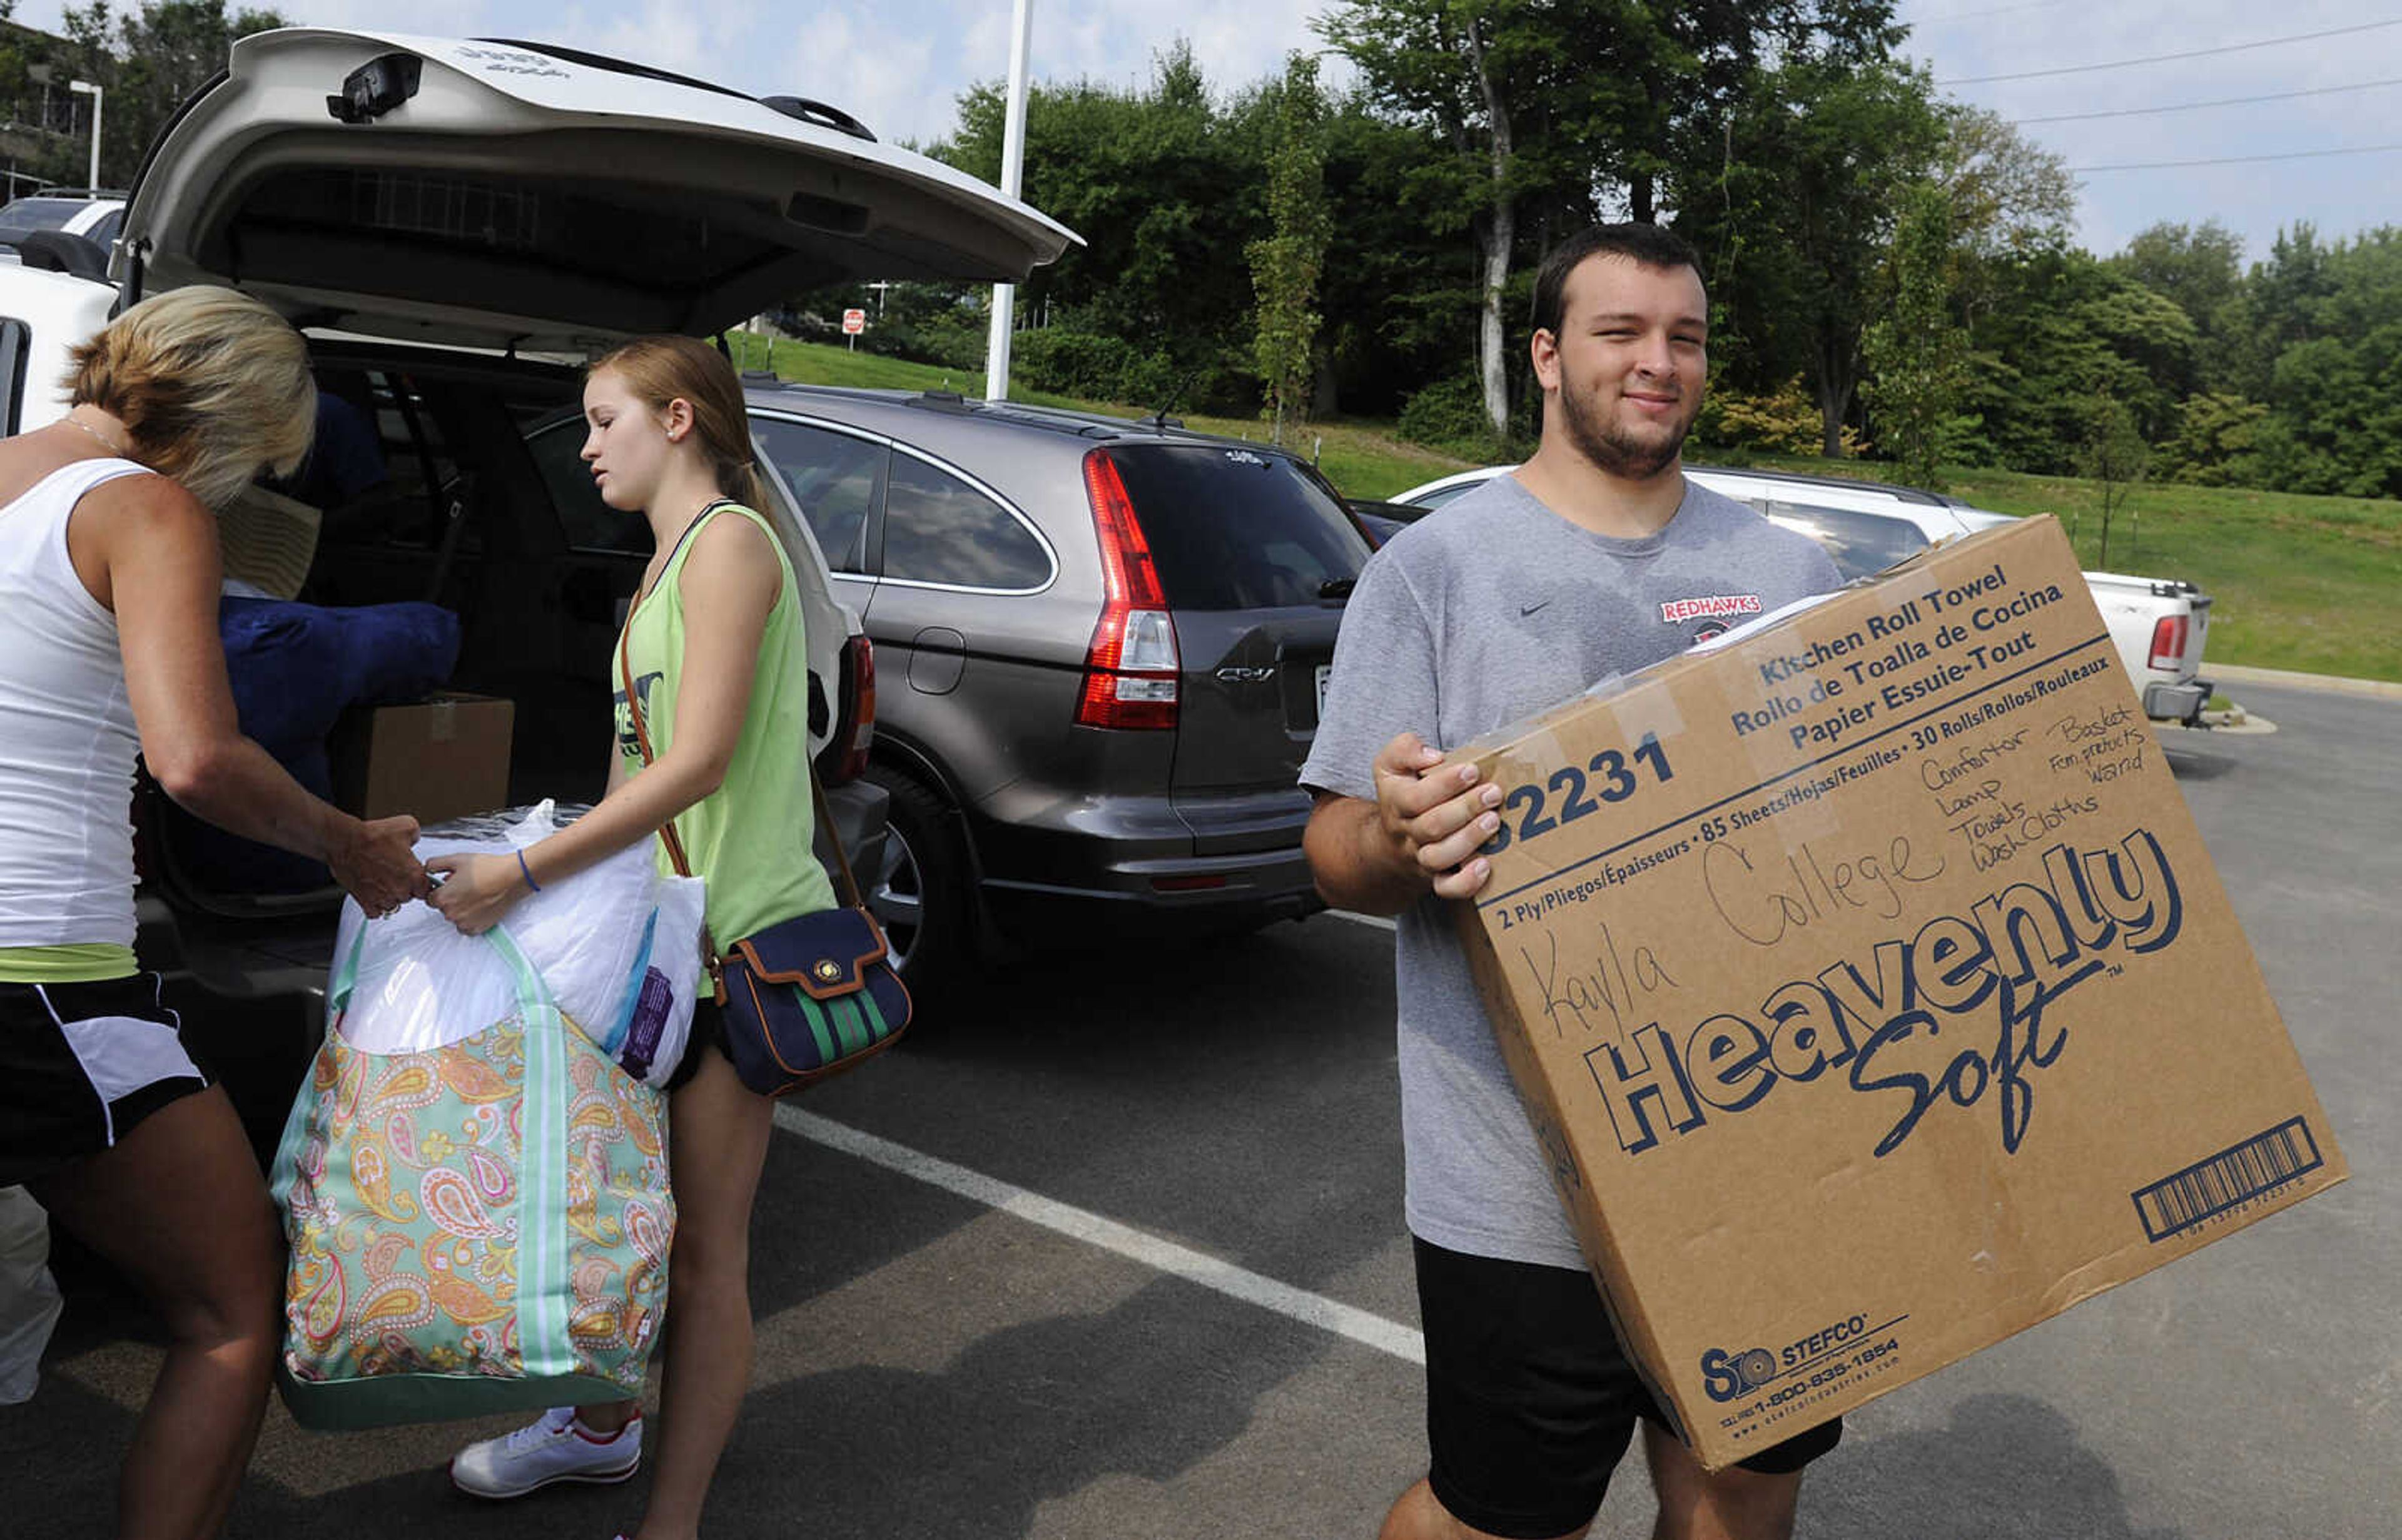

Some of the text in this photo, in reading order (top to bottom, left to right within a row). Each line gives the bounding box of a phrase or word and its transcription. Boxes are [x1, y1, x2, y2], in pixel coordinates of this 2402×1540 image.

[1663, 595, 1762, 621] REDHAWKS
[1730, 580, 2064, 737] Rollo de Toalla de Cocina
[1758, 564, 2007, 686] Kitchen Roll Towel
[1788, 629, 2037, 751] Papier Essuie-Tout
[2047, 705, 2136, 743] Basket
[1497, 656, 2111, 930] 2 Ply/Pliegos/Épaisseurs 85 Sheets/Hojas/Feuilles 30 Rolls/Rollos/Rouleaux
[1521, 836, 1945, 1043] Kayla College
[1583, 828, 2182, 1155] Heavenly
[1849, 959, 2106, 1157] Soft
[1781, 1315, 1865, 1367] STEFCO
